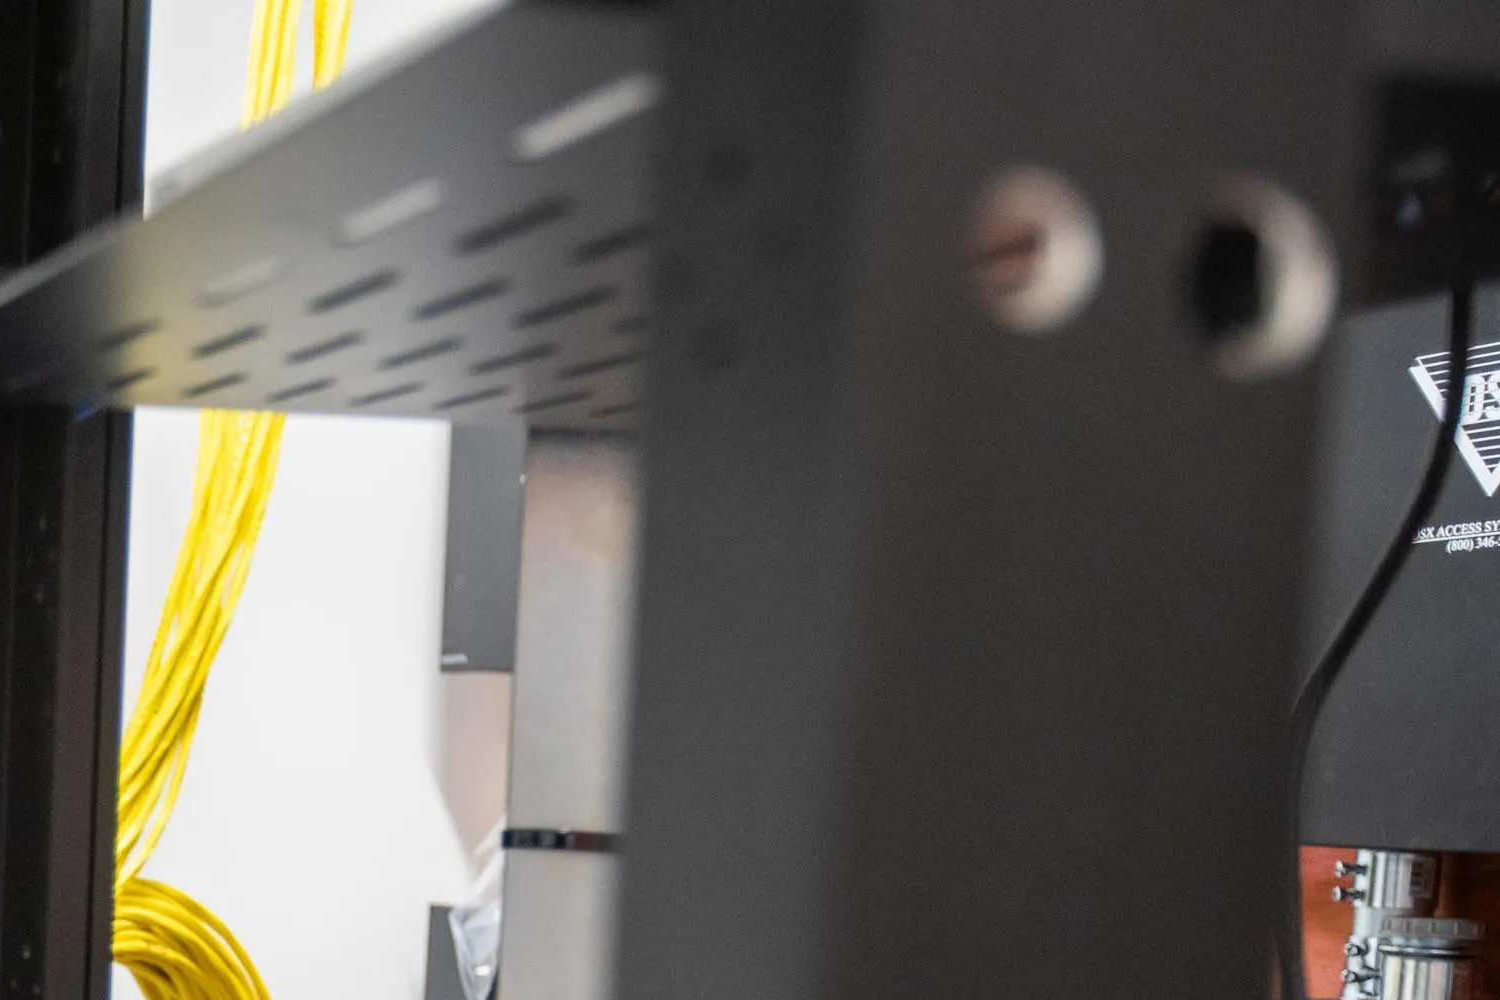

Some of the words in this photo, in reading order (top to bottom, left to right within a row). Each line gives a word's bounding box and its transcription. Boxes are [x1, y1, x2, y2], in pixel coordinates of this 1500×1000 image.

[1436, 521, 1482, 538] ACCESS
[1447, 538, 1475, 554] (800)
[1475, 535, 1500, 550] 346-
